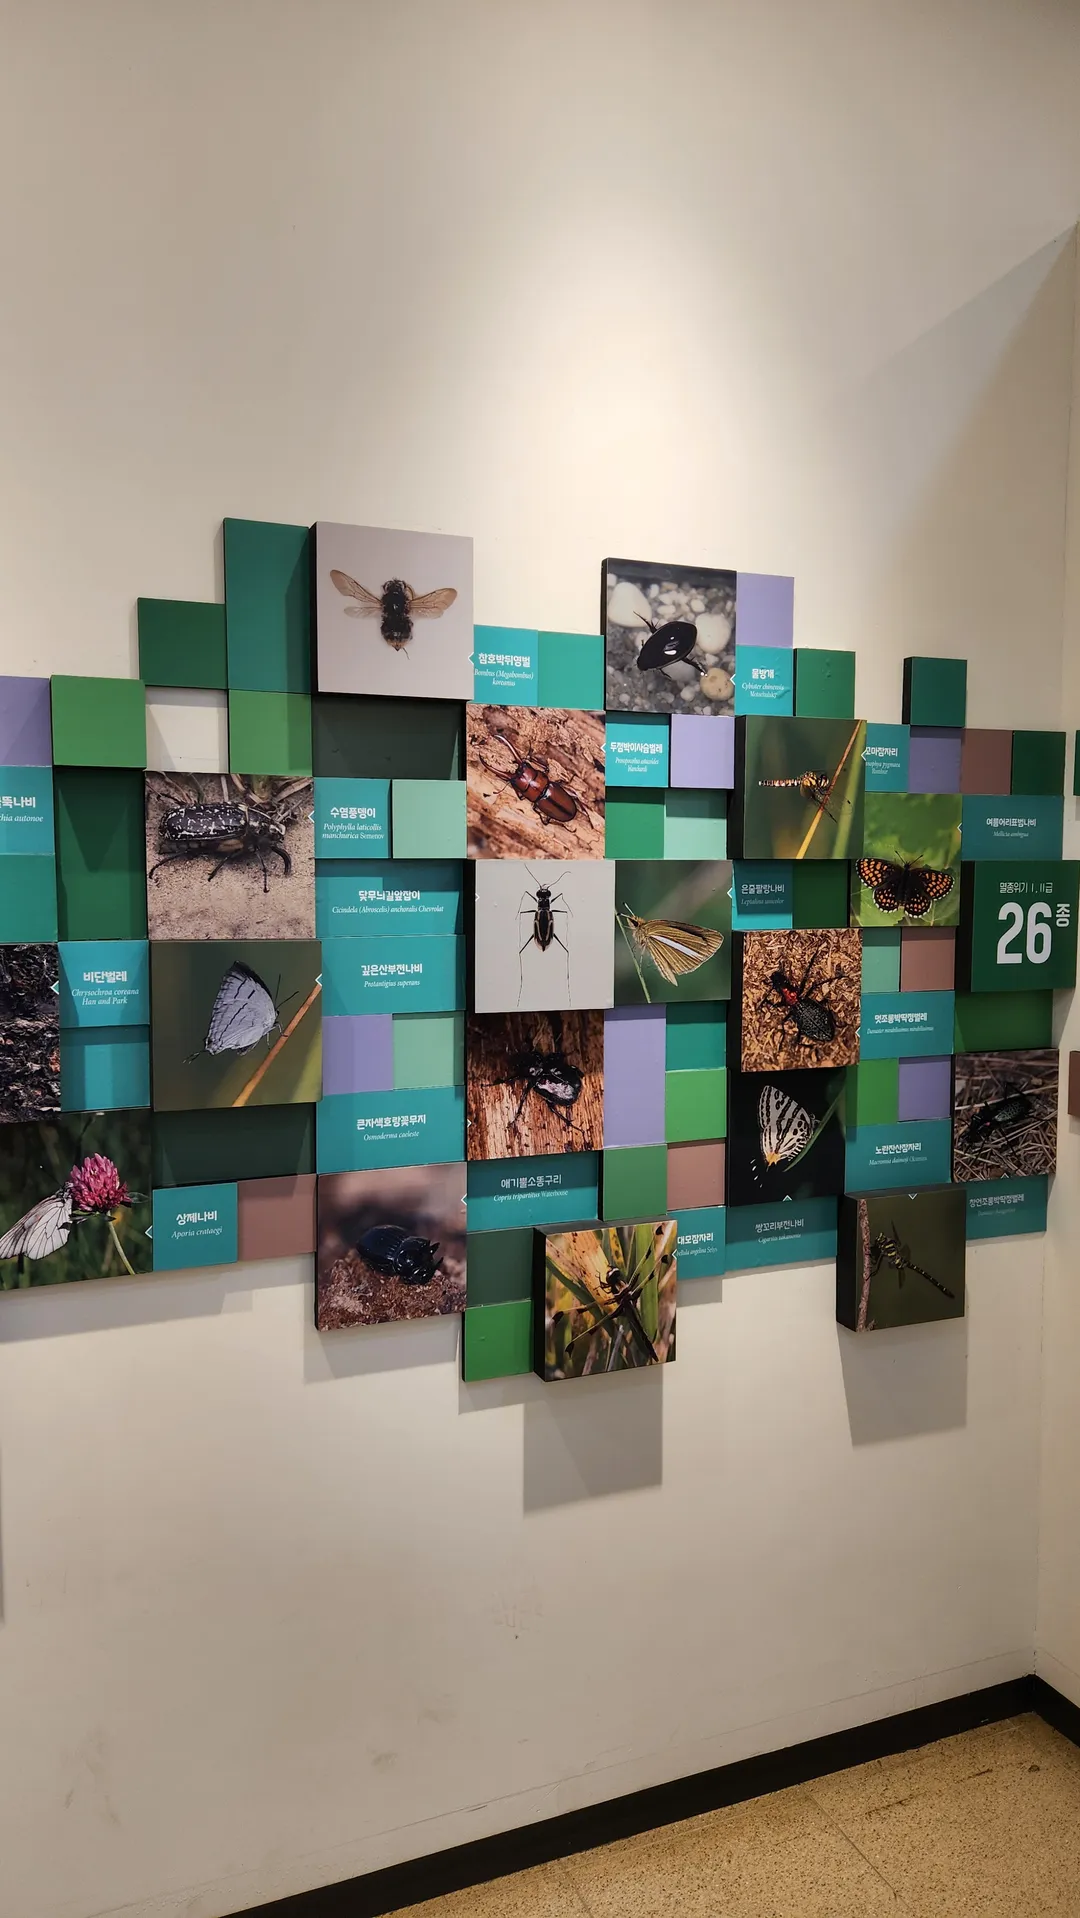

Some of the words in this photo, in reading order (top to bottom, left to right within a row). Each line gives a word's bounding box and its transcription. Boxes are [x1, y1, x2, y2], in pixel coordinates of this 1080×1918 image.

[751, 668, 775, 680] 물방개
[0, 795, 36, 809] 뚝나비
[330, 806, 377, 820] 수염풍뎅이
[323, 822, 356, 833] Polyphylla
[356, 823, 382, 832] laticollis
[741, 883, 786, 895] 은줄팔랑나비
[999, 882, 1028, 894] 멸종위기
[358, 889, 421, 902] 닻무늬길앞잡이
[331, 905, 358, 914] Cicindela
[1055, 903, 1071, 928] 종
[996, 901, 1053, 965] 26
[360, 963, 423, 977] 깊은산부전나비
[83, 970, 128, 984] 비단벌레
[71, 988, 113, 998] Chrysochroa
[113, 988, 140, 997] coreana
[81, 996, 97, 1006] Han
[97, 996, 111, 1005] and
[112, 996, 128, 1005] Park
[356, 1114, 427, 1131] 큰자색호랑꽃무지
[363, 1132, 398, 1141] Osmoderma
[500, 1174, 562, 1189] 애기뿔소똥구리
[493, 1193, 512, 1203] Copris
[175, 1210, 218, 1226] 상제나비
[170, 1229, 196, 1240] Aporia
[195, 1225, 224, 1236] crataegi
[755, 1218, 805, 1234] 쌍꼬리부전나비
[677, 1232, 714, 1245] 대모잠자리
